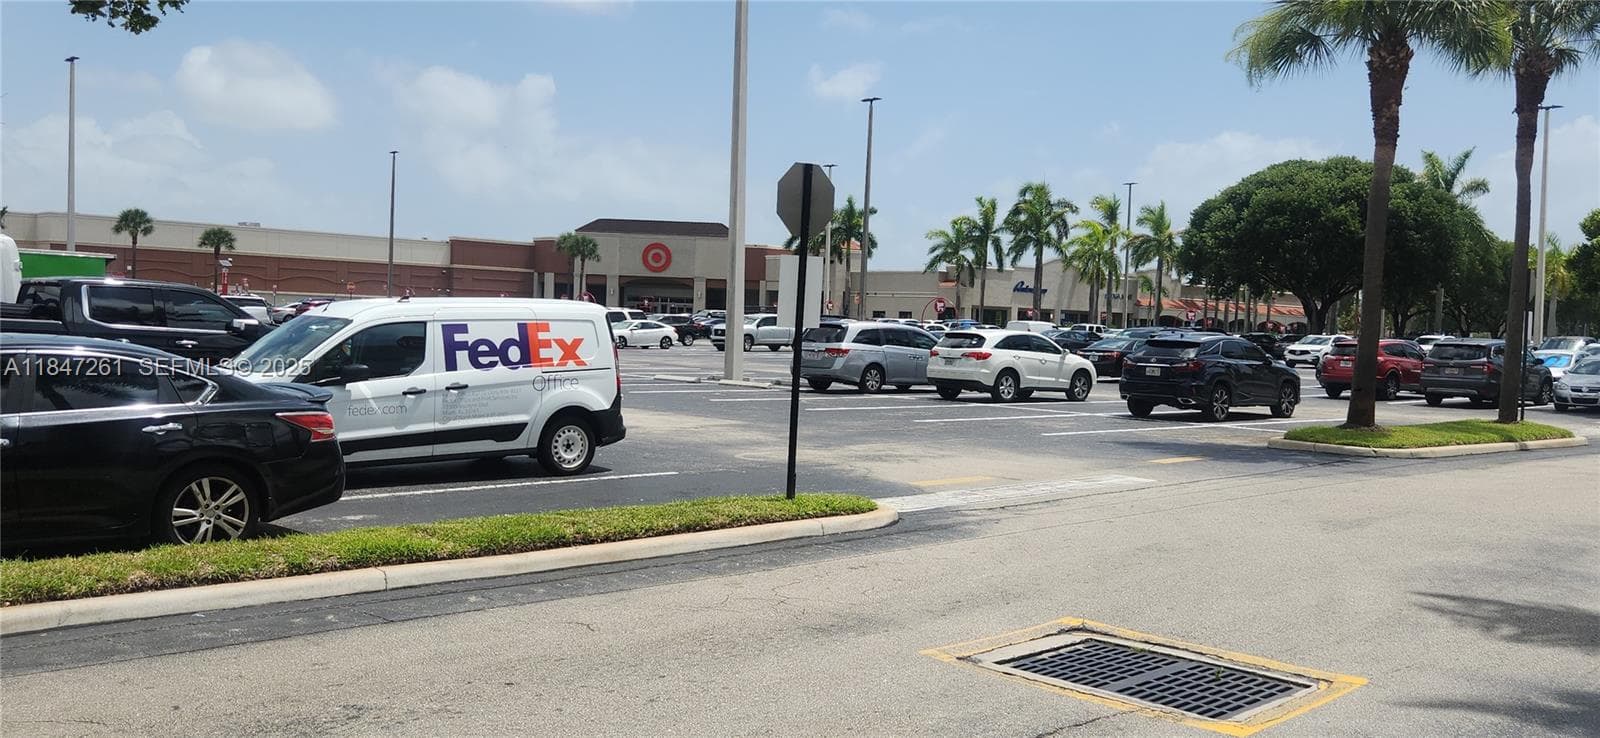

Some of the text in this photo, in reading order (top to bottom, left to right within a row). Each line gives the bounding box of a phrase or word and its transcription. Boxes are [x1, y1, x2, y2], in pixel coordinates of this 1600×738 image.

[441, 322, 588, 371] FedEx
[532, 374, 579, 392] Office
[347, 402, 408, 416] fedex.com
